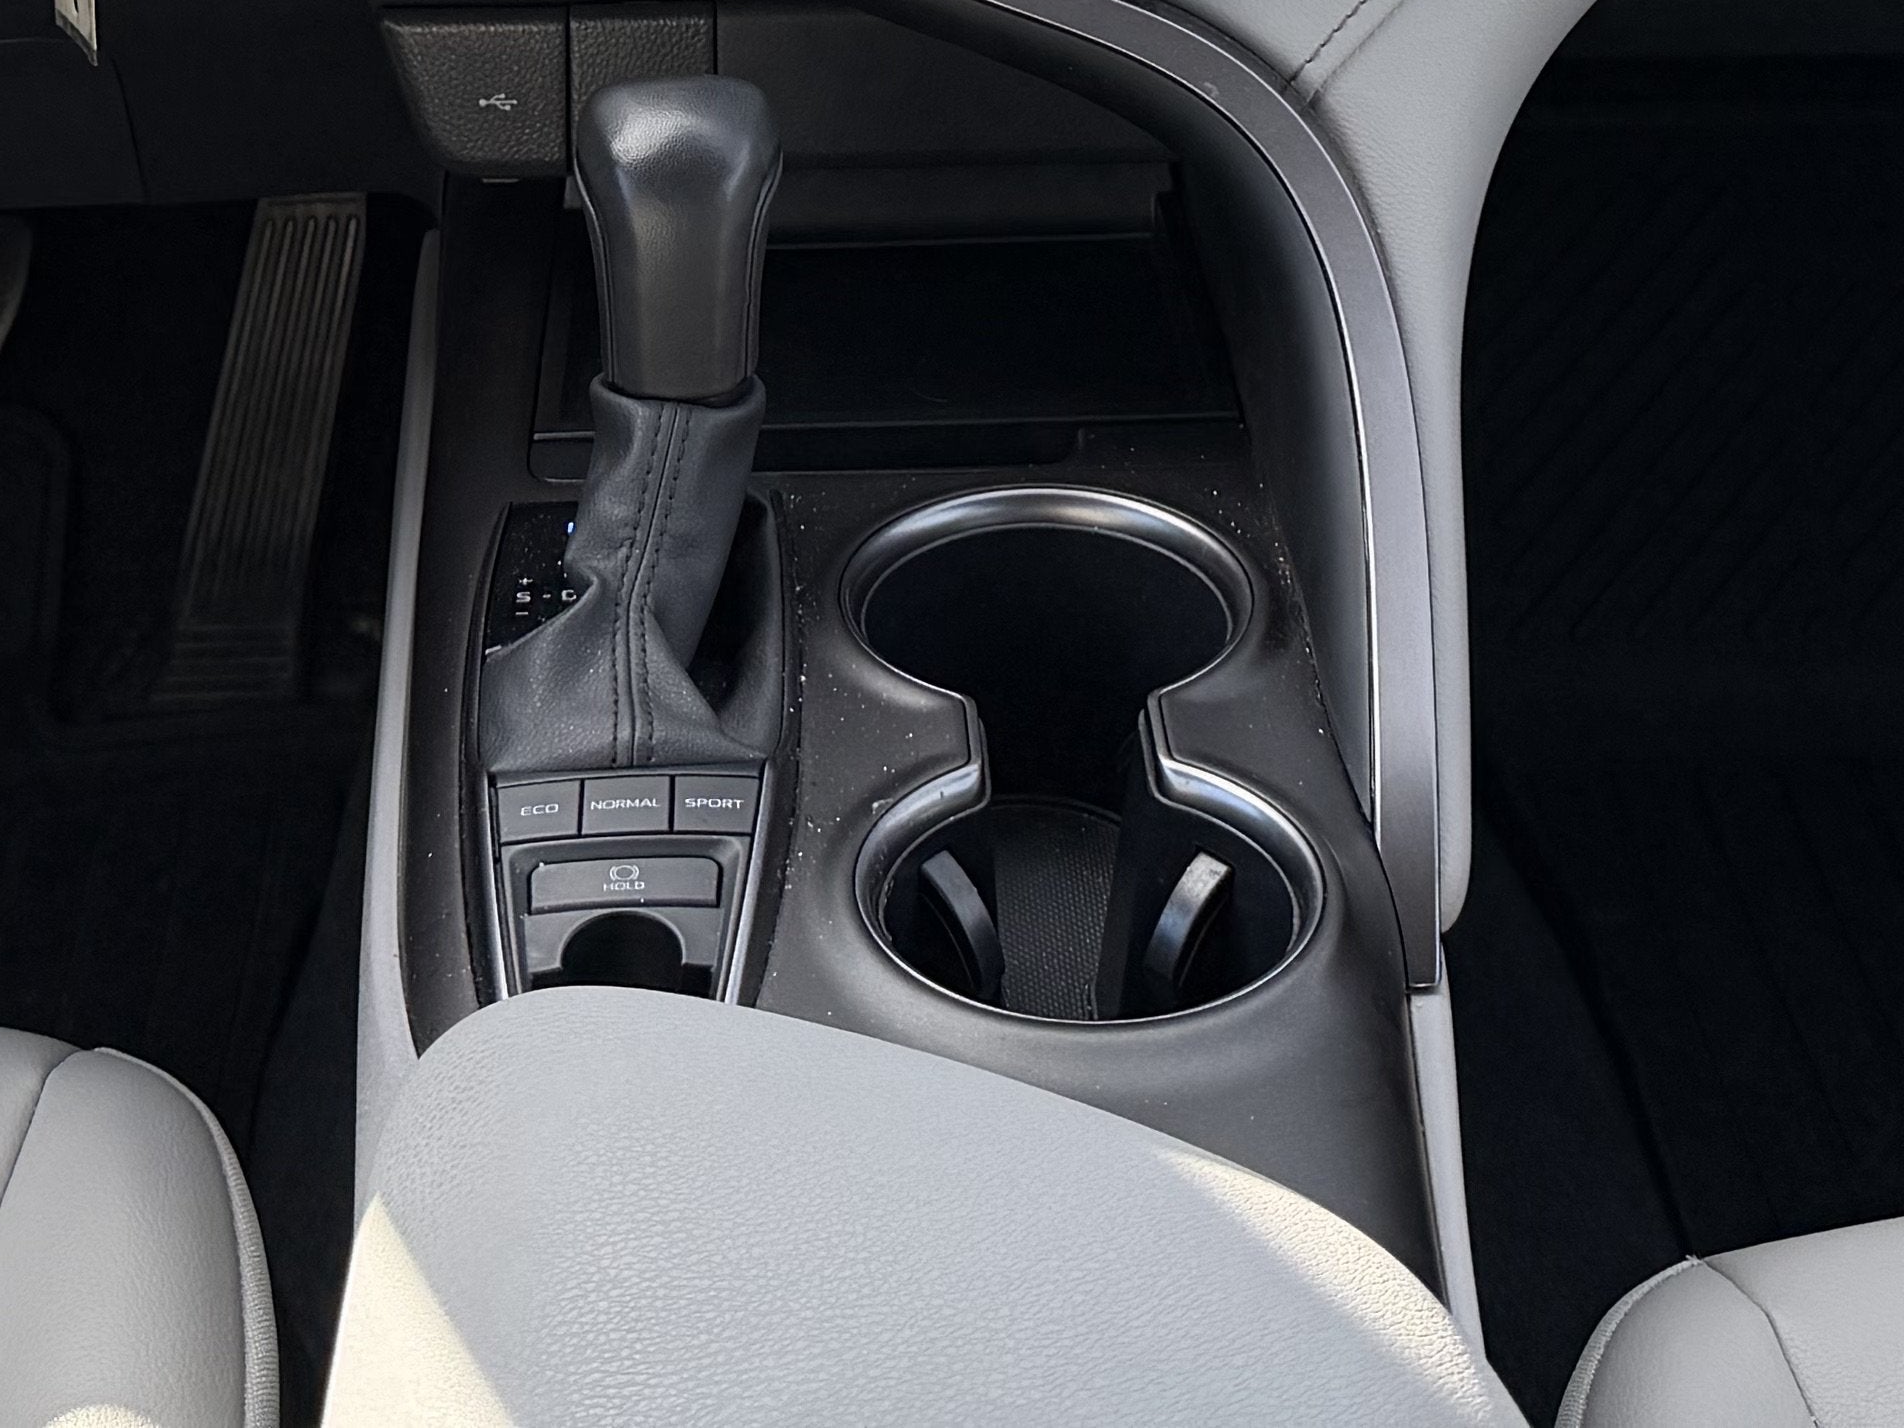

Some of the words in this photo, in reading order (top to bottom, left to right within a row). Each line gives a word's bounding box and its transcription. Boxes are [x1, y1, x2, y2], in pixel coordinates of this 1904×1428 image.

[515, 590, 532, 604] S
[520, 802, 560, 817] ECO
[589, 796, 661, 811] NORMAL
[684, 796, 745, 811] SPORT
[602, 880, 646, 893] HOLD
